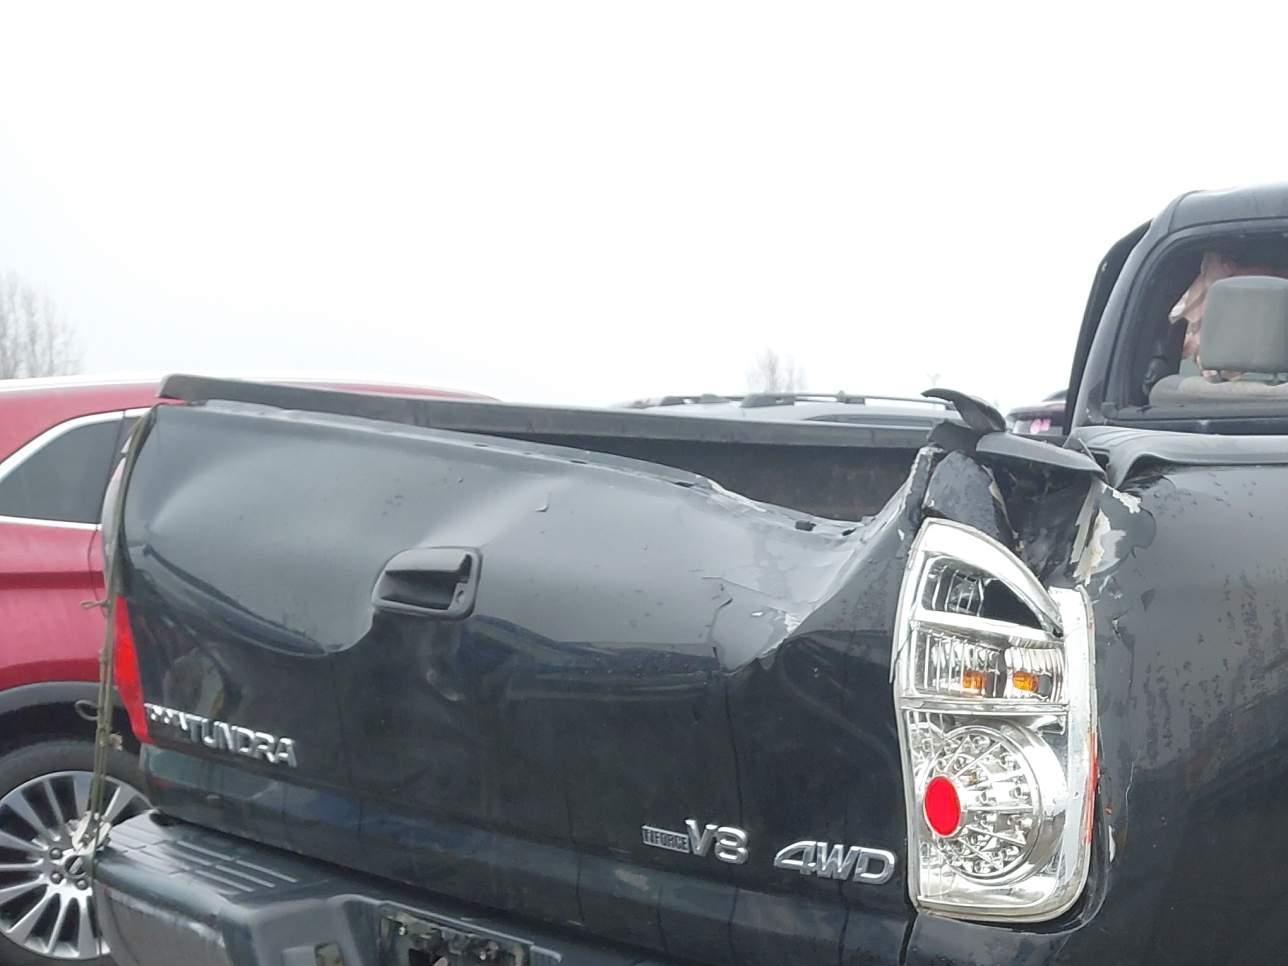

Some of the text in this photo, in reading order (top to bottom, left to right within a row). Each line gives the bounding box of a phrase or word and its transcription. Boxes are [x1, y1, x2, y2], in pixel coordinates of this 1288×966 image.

[184, 713, 297, 768] TUNDRA
[685, 819, 748, 864] V8
[774, 840, 896, 885] 4WD
